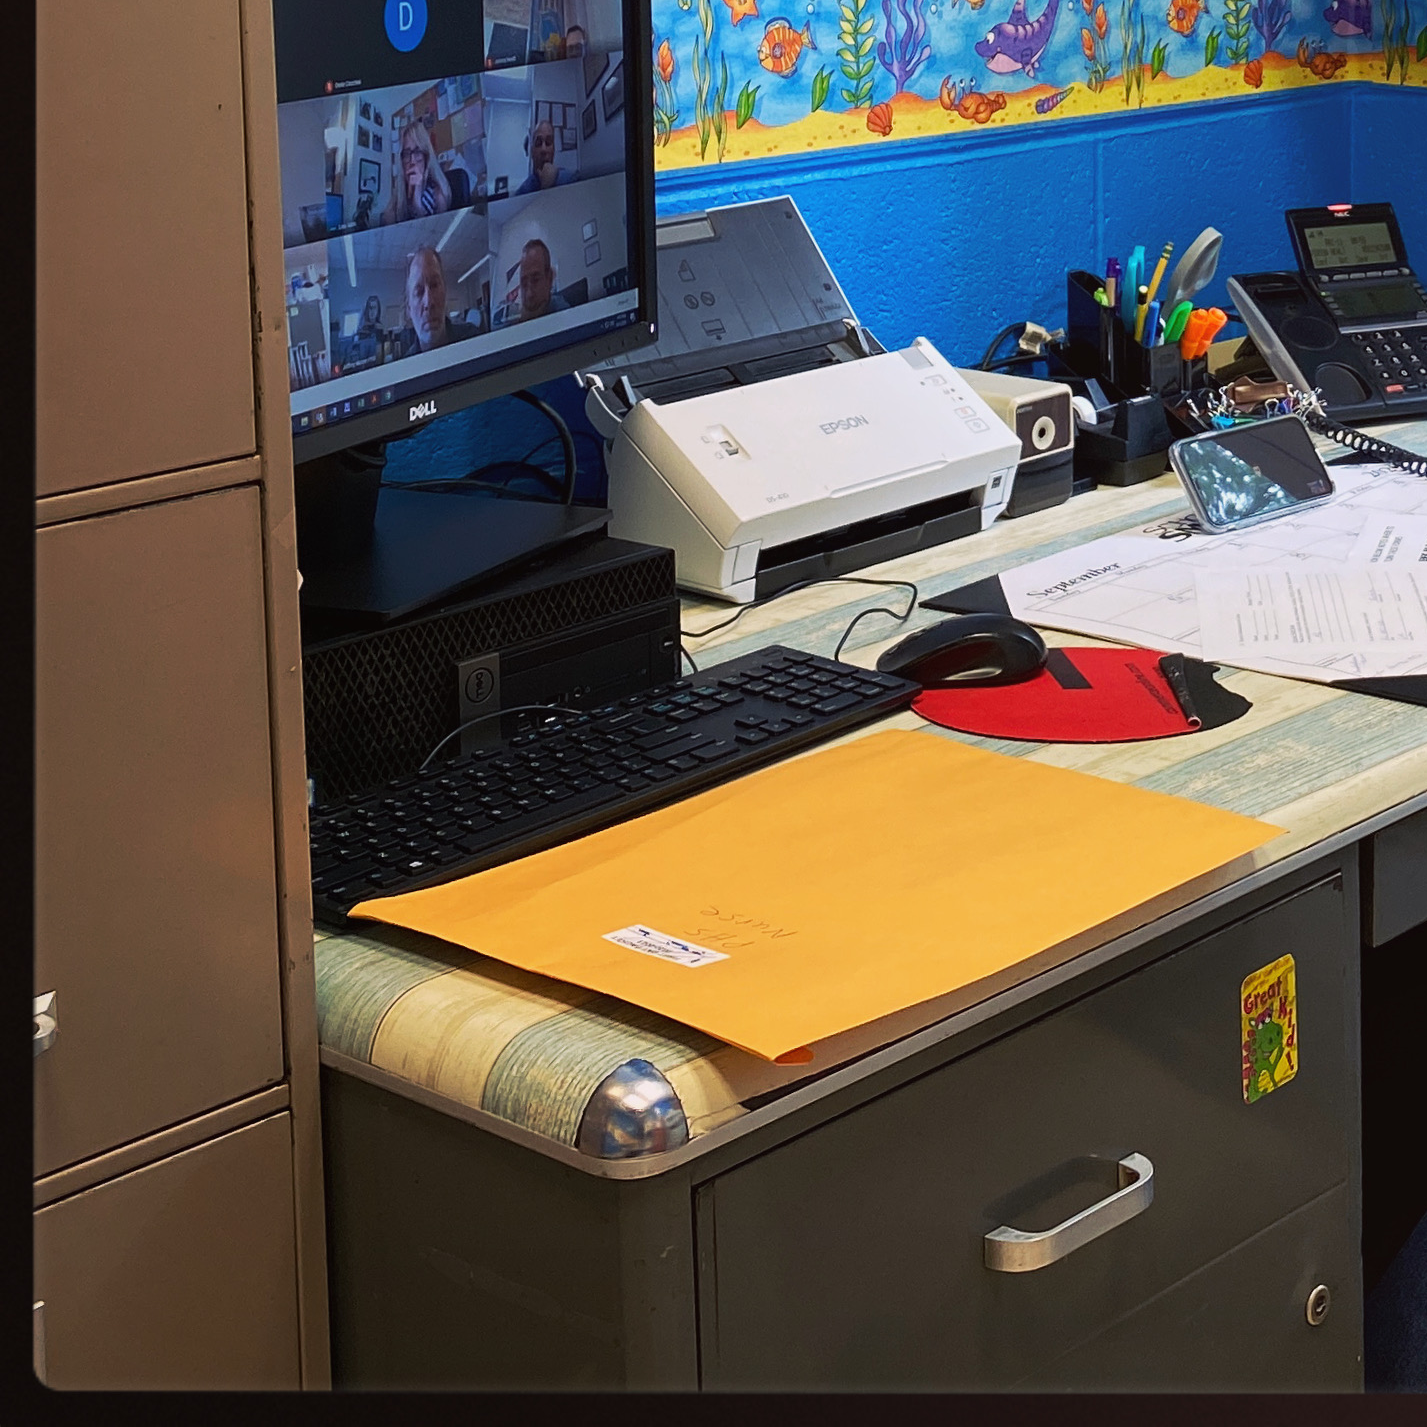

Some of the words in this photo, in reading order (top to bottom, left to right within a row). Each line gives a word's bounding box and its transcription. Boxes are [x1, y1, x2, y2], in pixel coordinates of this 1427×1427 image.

[399, 1, 413, 32] D
[409, 399, 438, 422] DELL
[818, 414, 870, 435] EPSON
[1026, 561, 1122, 599] September
[699, 905, 799, 941] Nurse
[1242, 975, 1283, 1015] Great
